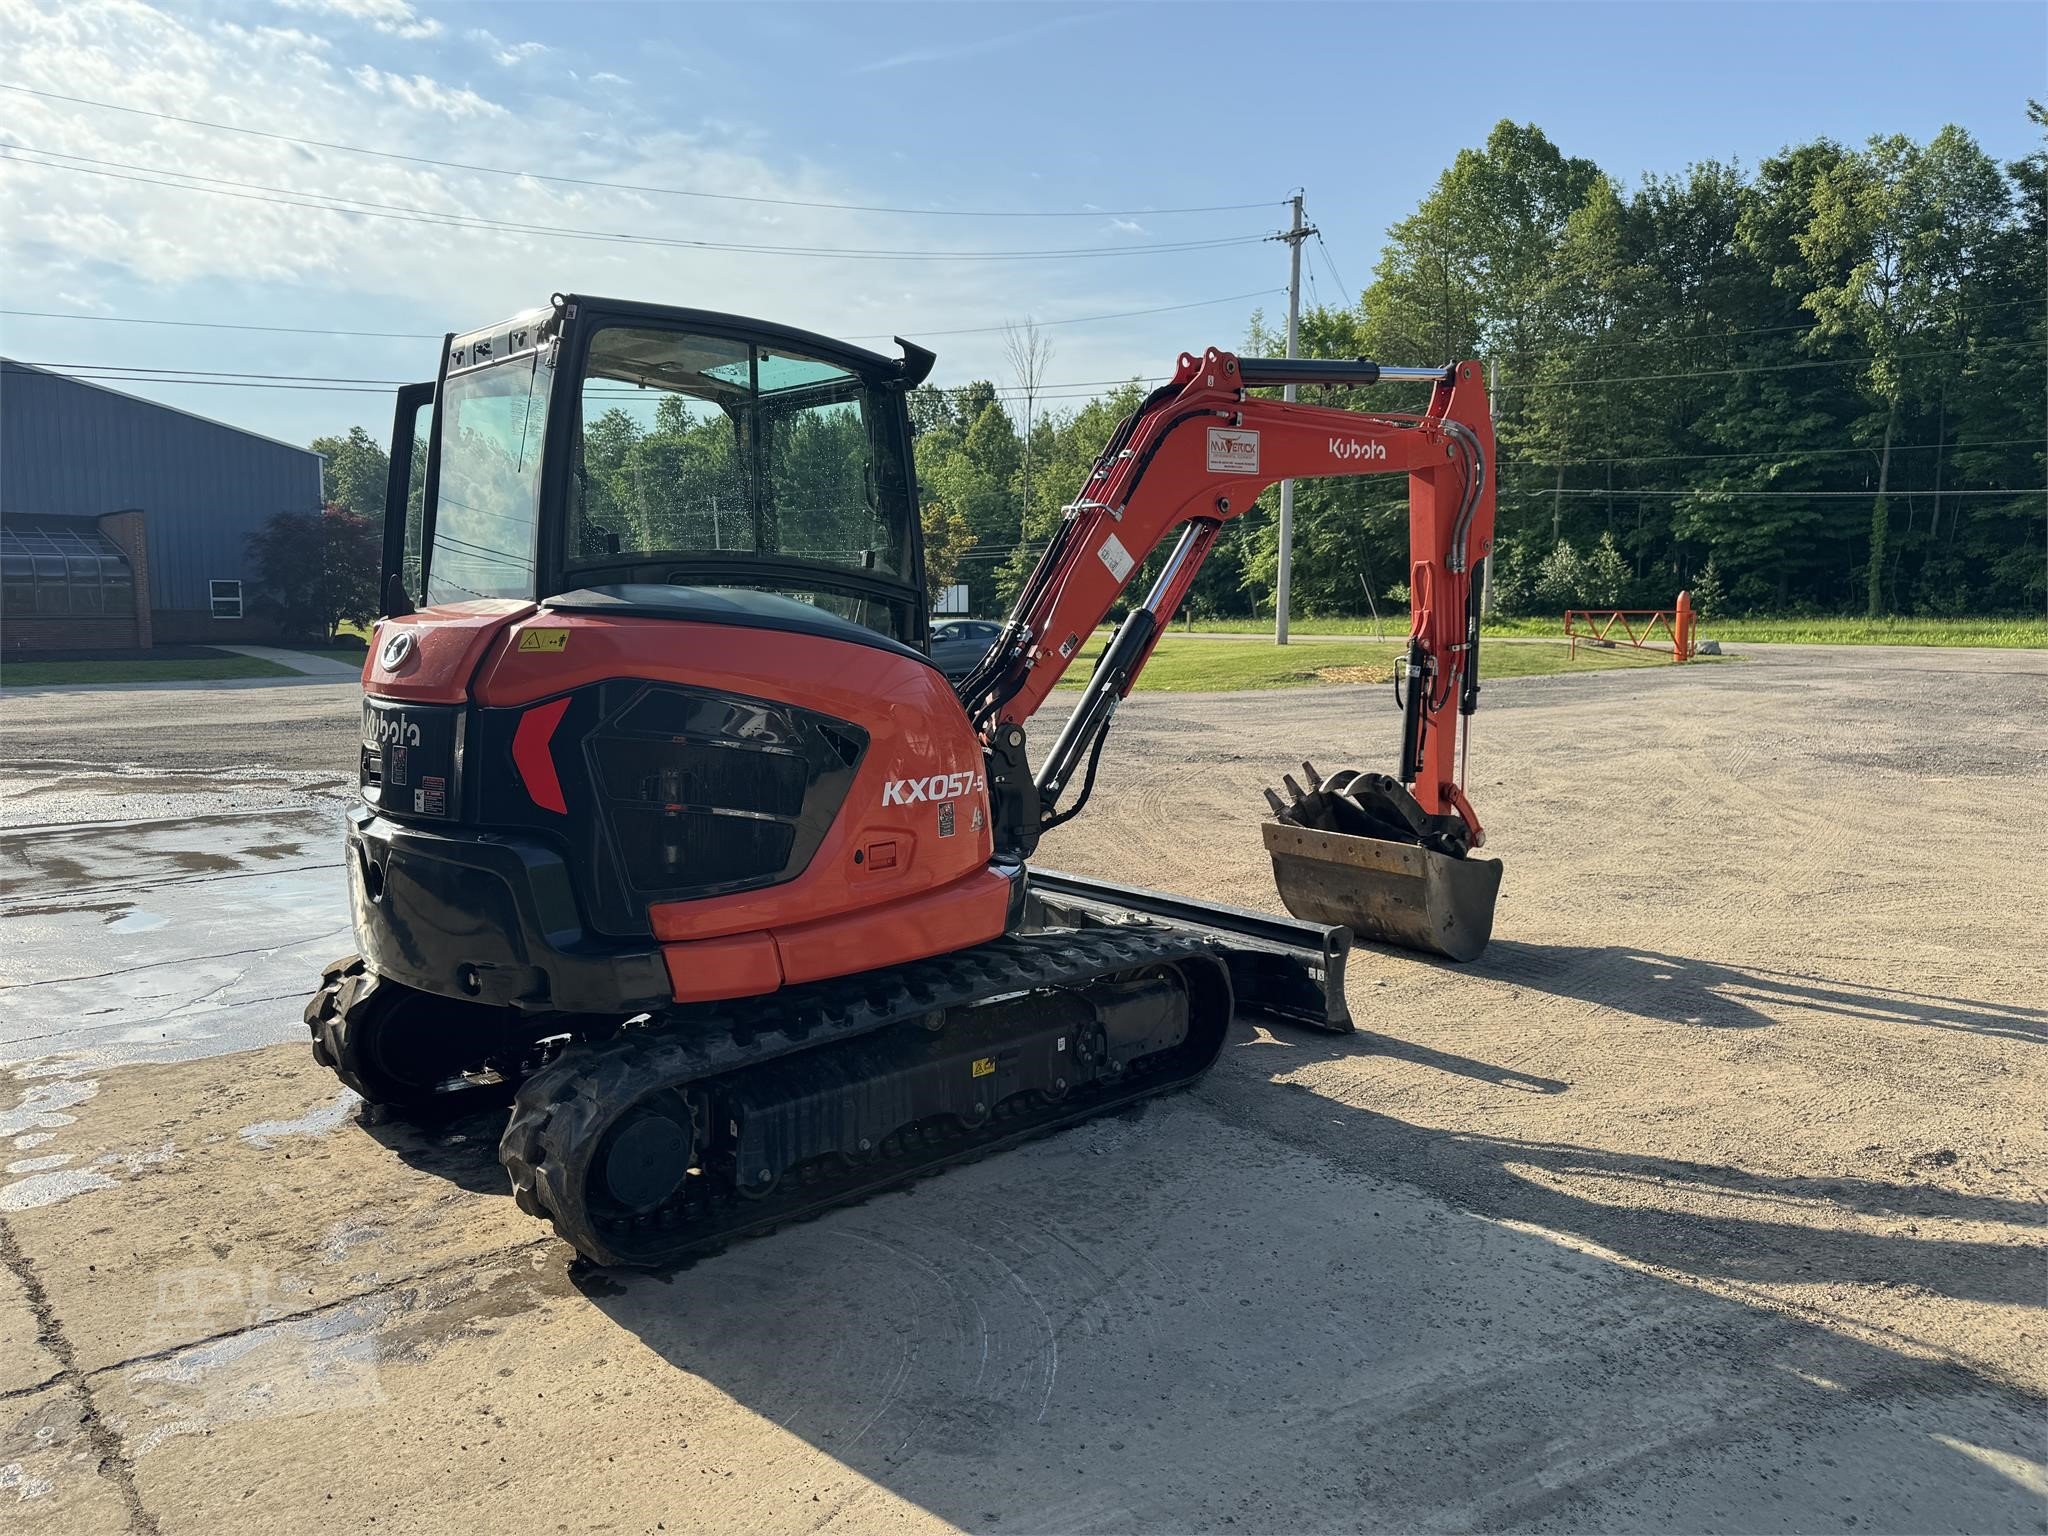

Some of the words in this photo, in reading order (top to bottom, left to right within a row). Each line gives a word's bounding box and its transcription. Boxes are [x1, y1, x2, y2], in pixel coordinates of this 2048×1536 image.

[1210, 440, 1256, 454] MAVERICK
[1328, 438, 1386, 460] Kubota
[366, 708, 420, 746] Kubota
[882, 771, 983, 807] KX057-5
